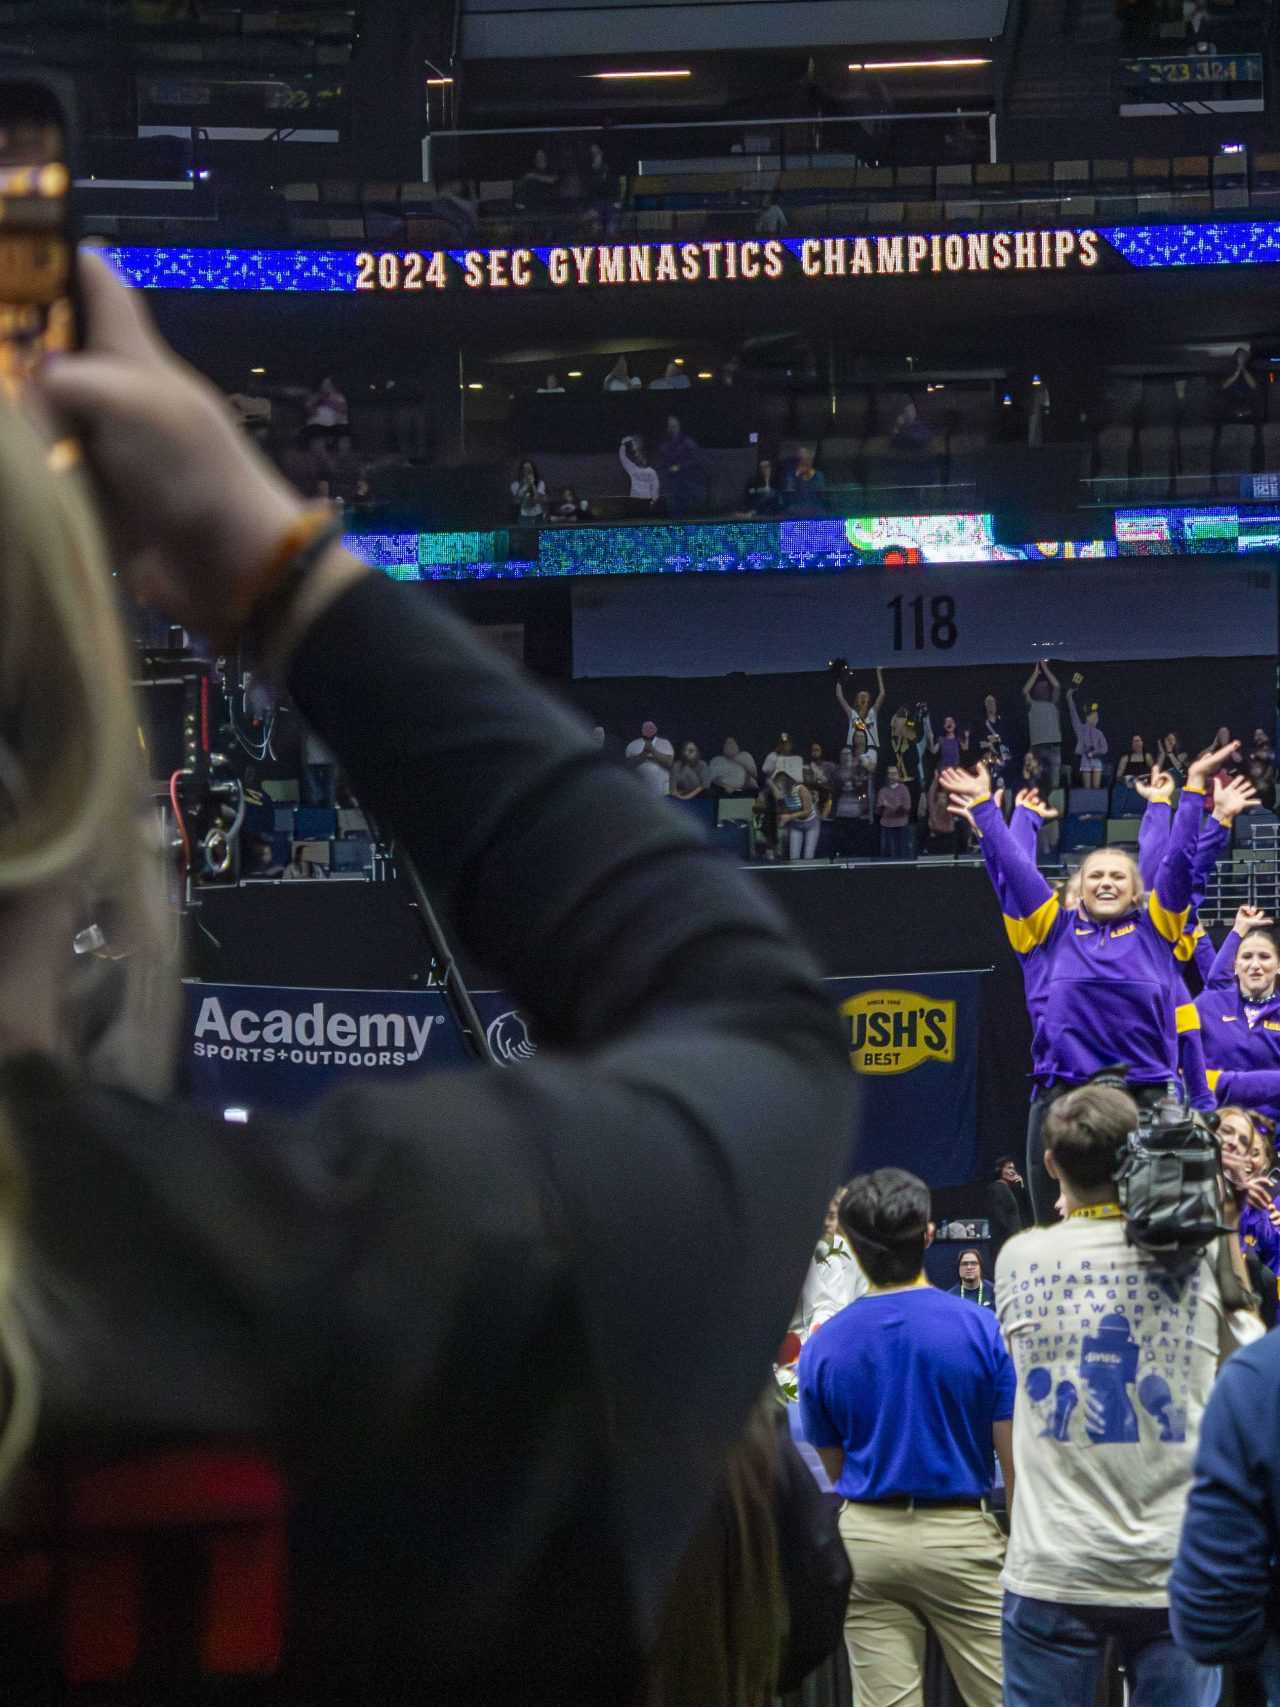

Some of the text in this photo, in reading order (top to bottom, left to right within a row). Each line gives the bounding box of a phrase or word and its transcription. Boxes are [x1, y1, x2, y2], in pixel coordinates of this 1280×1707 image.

[355, 230, 1098, 289] 2024 SEC GYMNASTICS CHAMPIONSHIPS
[887, 594, 957, 651] 118
[193, 996, 435, 1061] Academy
[849, 1008, 947, 1052] USH'S
[193, 1042, 406, 1067] SPORTS+OUTDOORS
[864, 1053, 901, 1065] BEST
